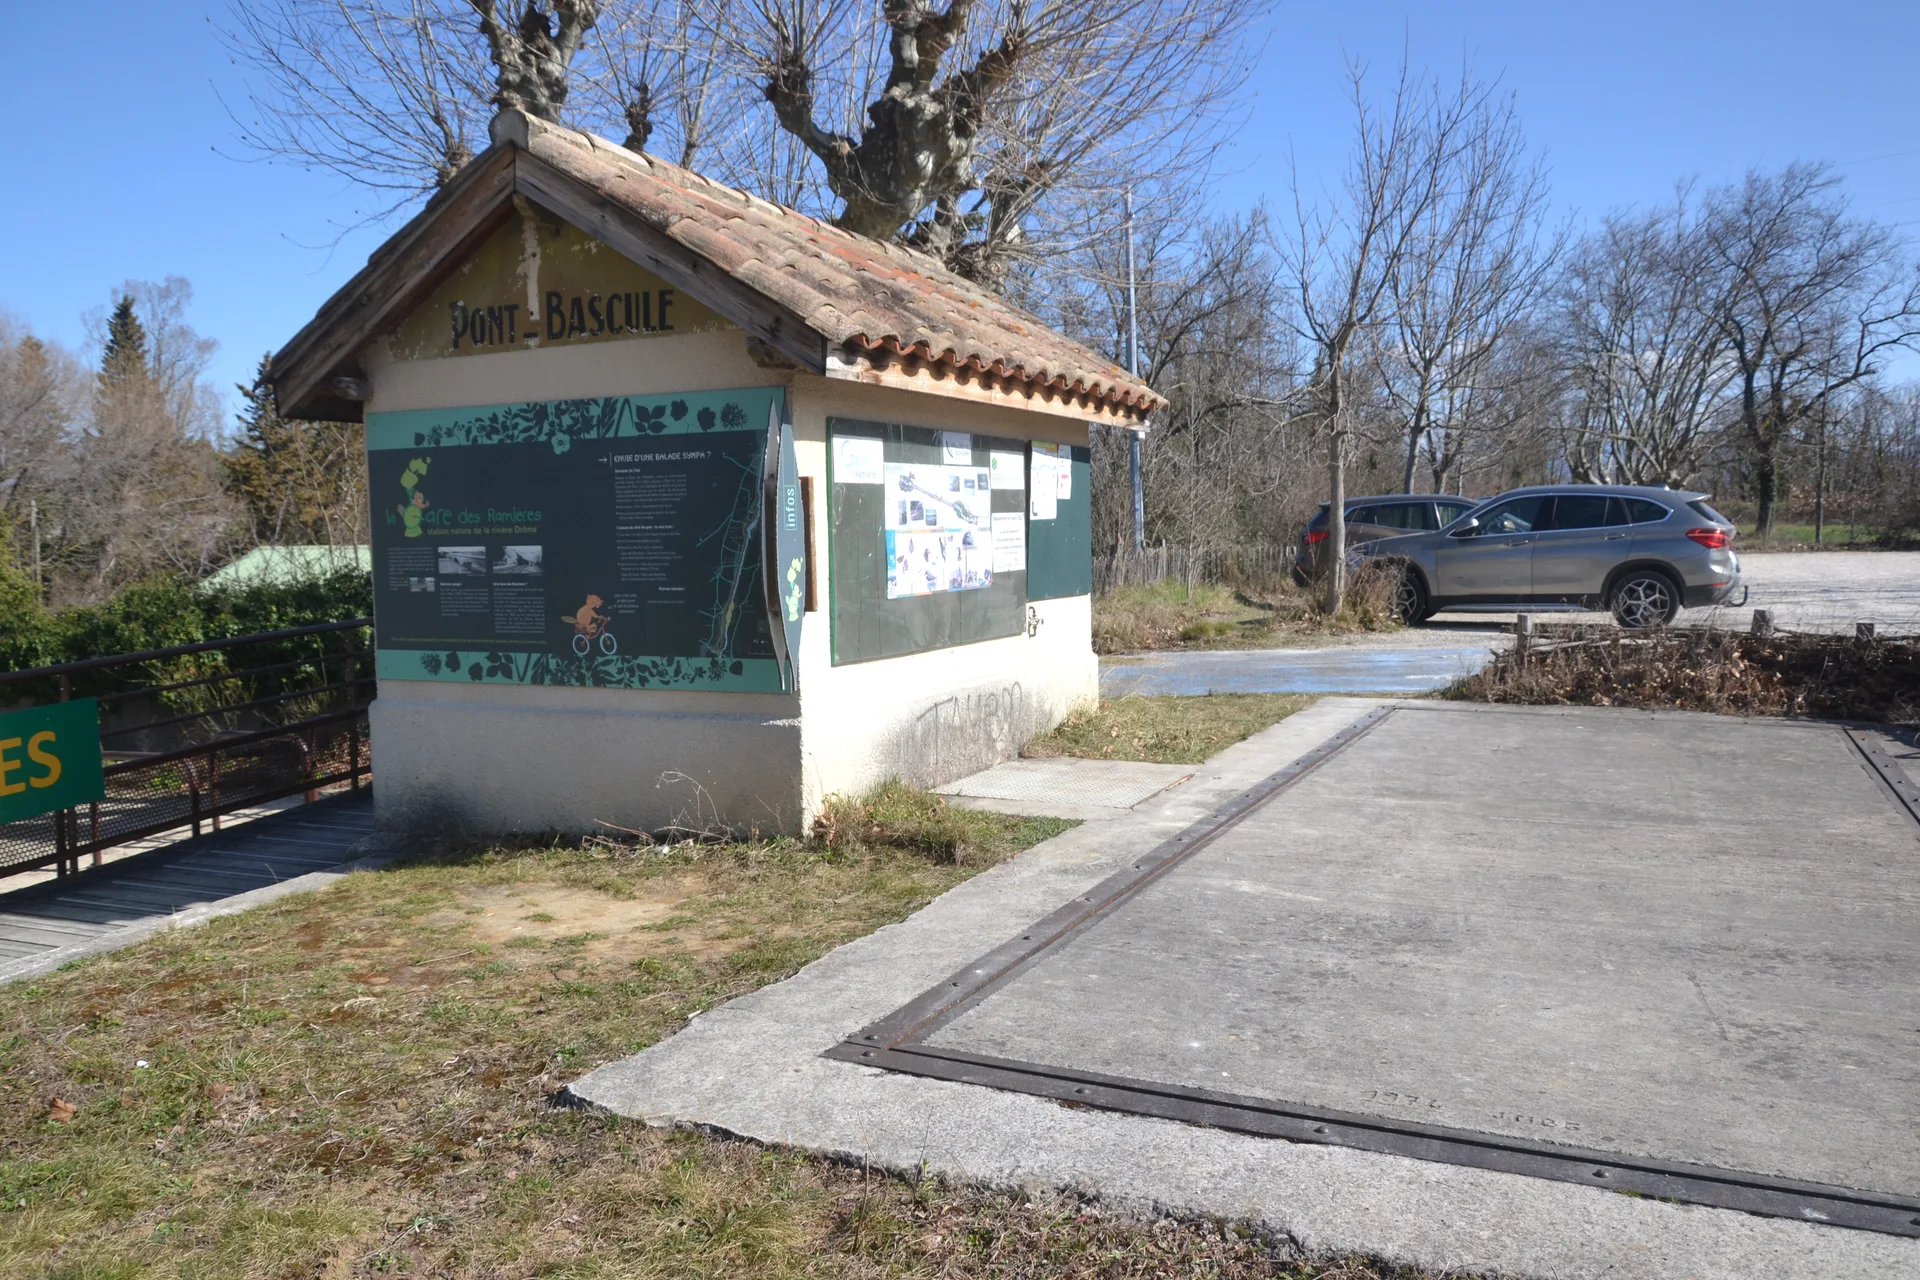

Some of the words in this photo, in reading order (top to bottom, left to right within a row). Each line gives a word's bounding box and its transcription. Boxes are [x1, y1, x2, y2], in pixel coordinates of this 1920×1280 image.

[450, 301, 519, 349] PONT
[546, 289, 674, 340] BASCULE
[613, 455, 633, 463] ENVIE
[634, 453, 654, 462] D'UNE
[655, 452, 681, 461] BALADE
[682, 451, 706, 460] SYMPA
[458, 508, 481, 525] des
[487, 506, 542, 523] Ramières
[785, 488, 796, 527] infos
[427, 527, 449, 535] station
[450, 527, 472, 535] nature
[473, 526, 482, 534] de
[483, 526, 490, 534] la
[491, 526, 513, 534] rivière
[514, 525, 538, 534] Drôme
[0, 730, 62, 797] ES
